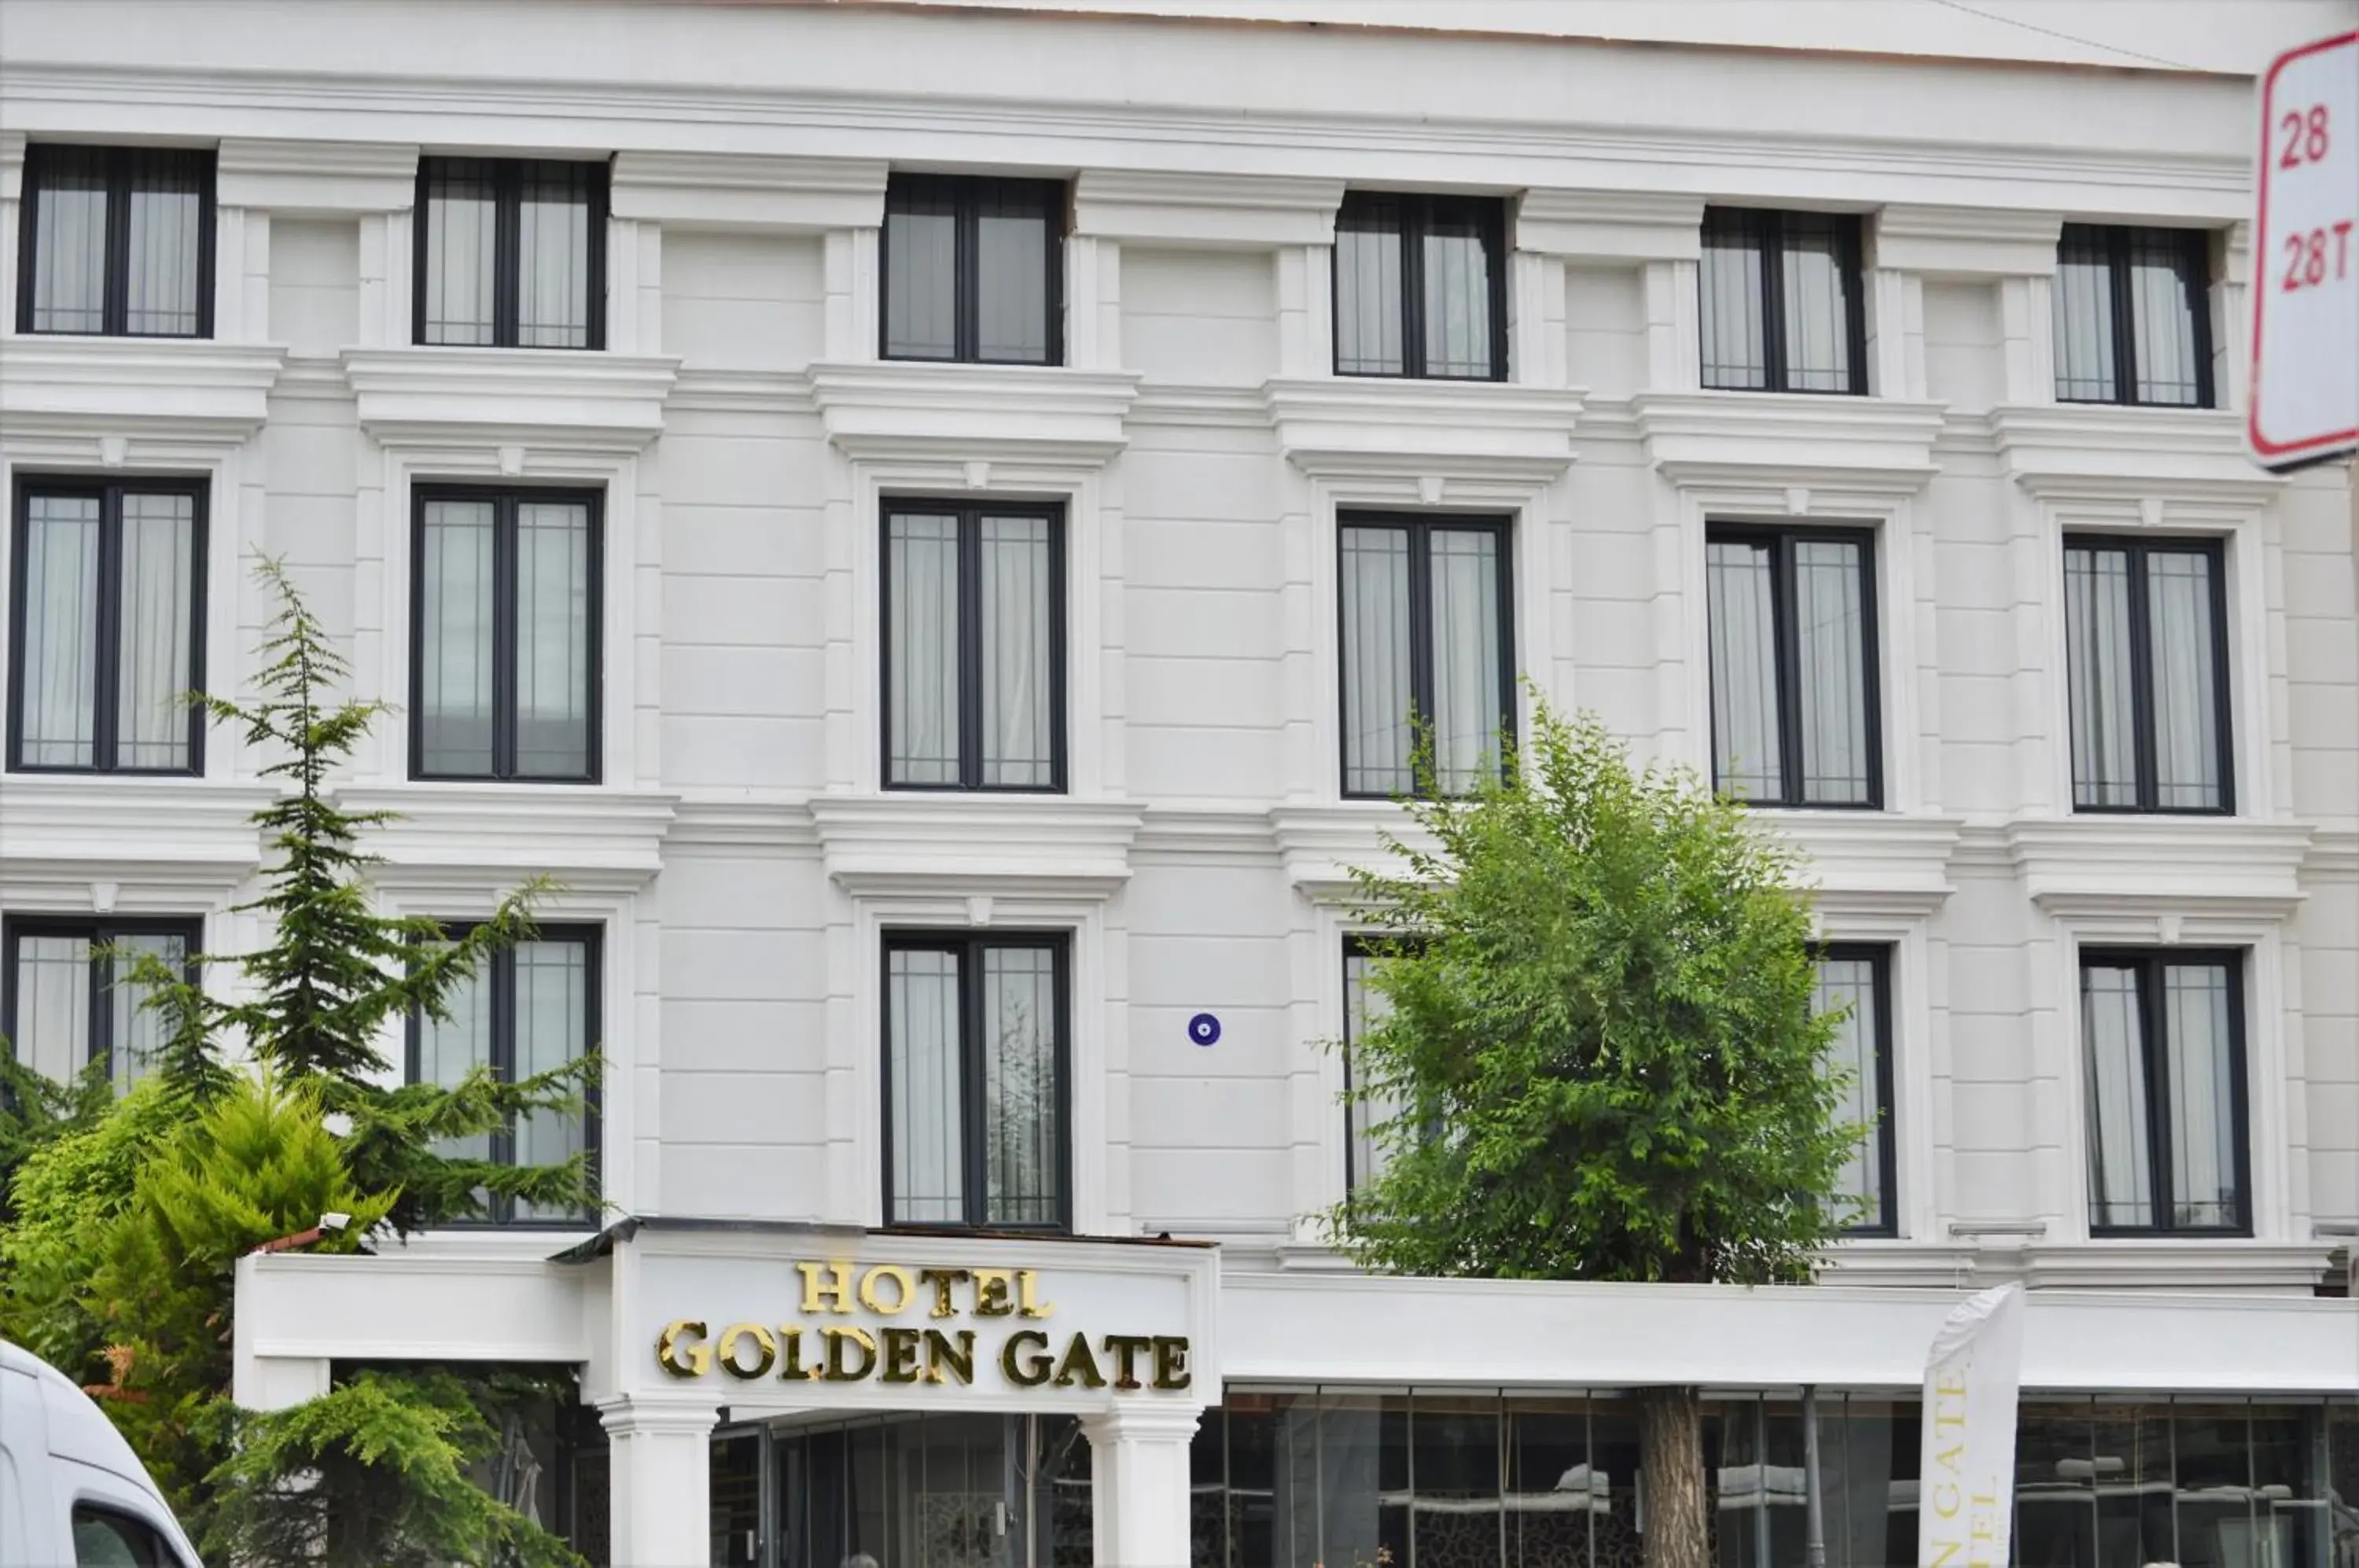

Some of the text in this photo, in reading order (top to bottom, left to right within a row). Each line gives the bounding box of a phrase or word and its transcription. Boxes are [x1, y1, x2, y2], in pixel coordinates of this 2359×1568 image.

[2280, 105, 2328, 169] 28
[2282, 221, 2354, 293] 28T
[796, 1260, 1055, 1319] HOTEL
[656, 1319, 1191, 1390] GOLDEN GATE
[1932, 1369, 1966, 1520] GATE
